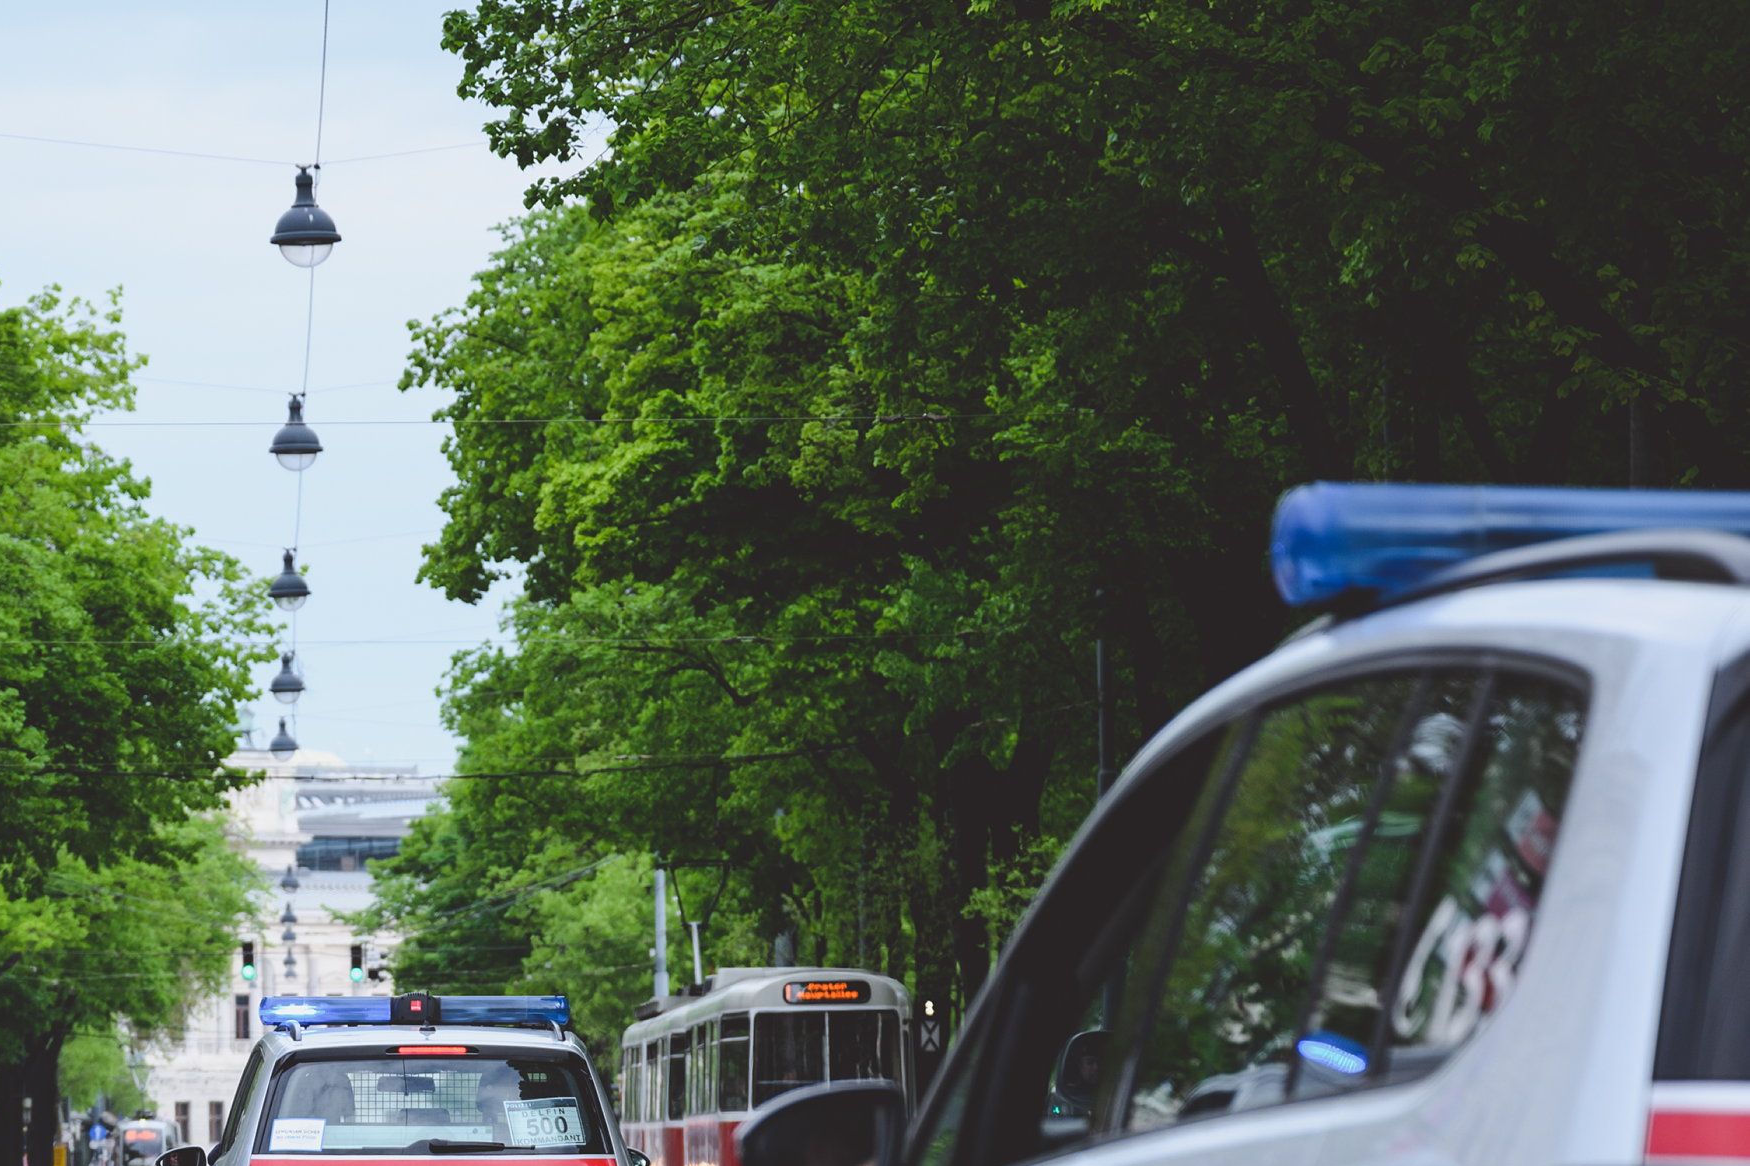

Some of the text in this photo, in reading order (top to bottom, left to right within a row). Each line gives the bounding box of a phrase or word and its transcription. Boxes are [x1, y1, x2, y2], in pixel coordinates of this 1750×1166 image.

[521, 1107, 566, 1118] DELFIN
[526, 1115, 569, 1137] 500
[516, 1134, 581, 1146] KOMMANDANT
